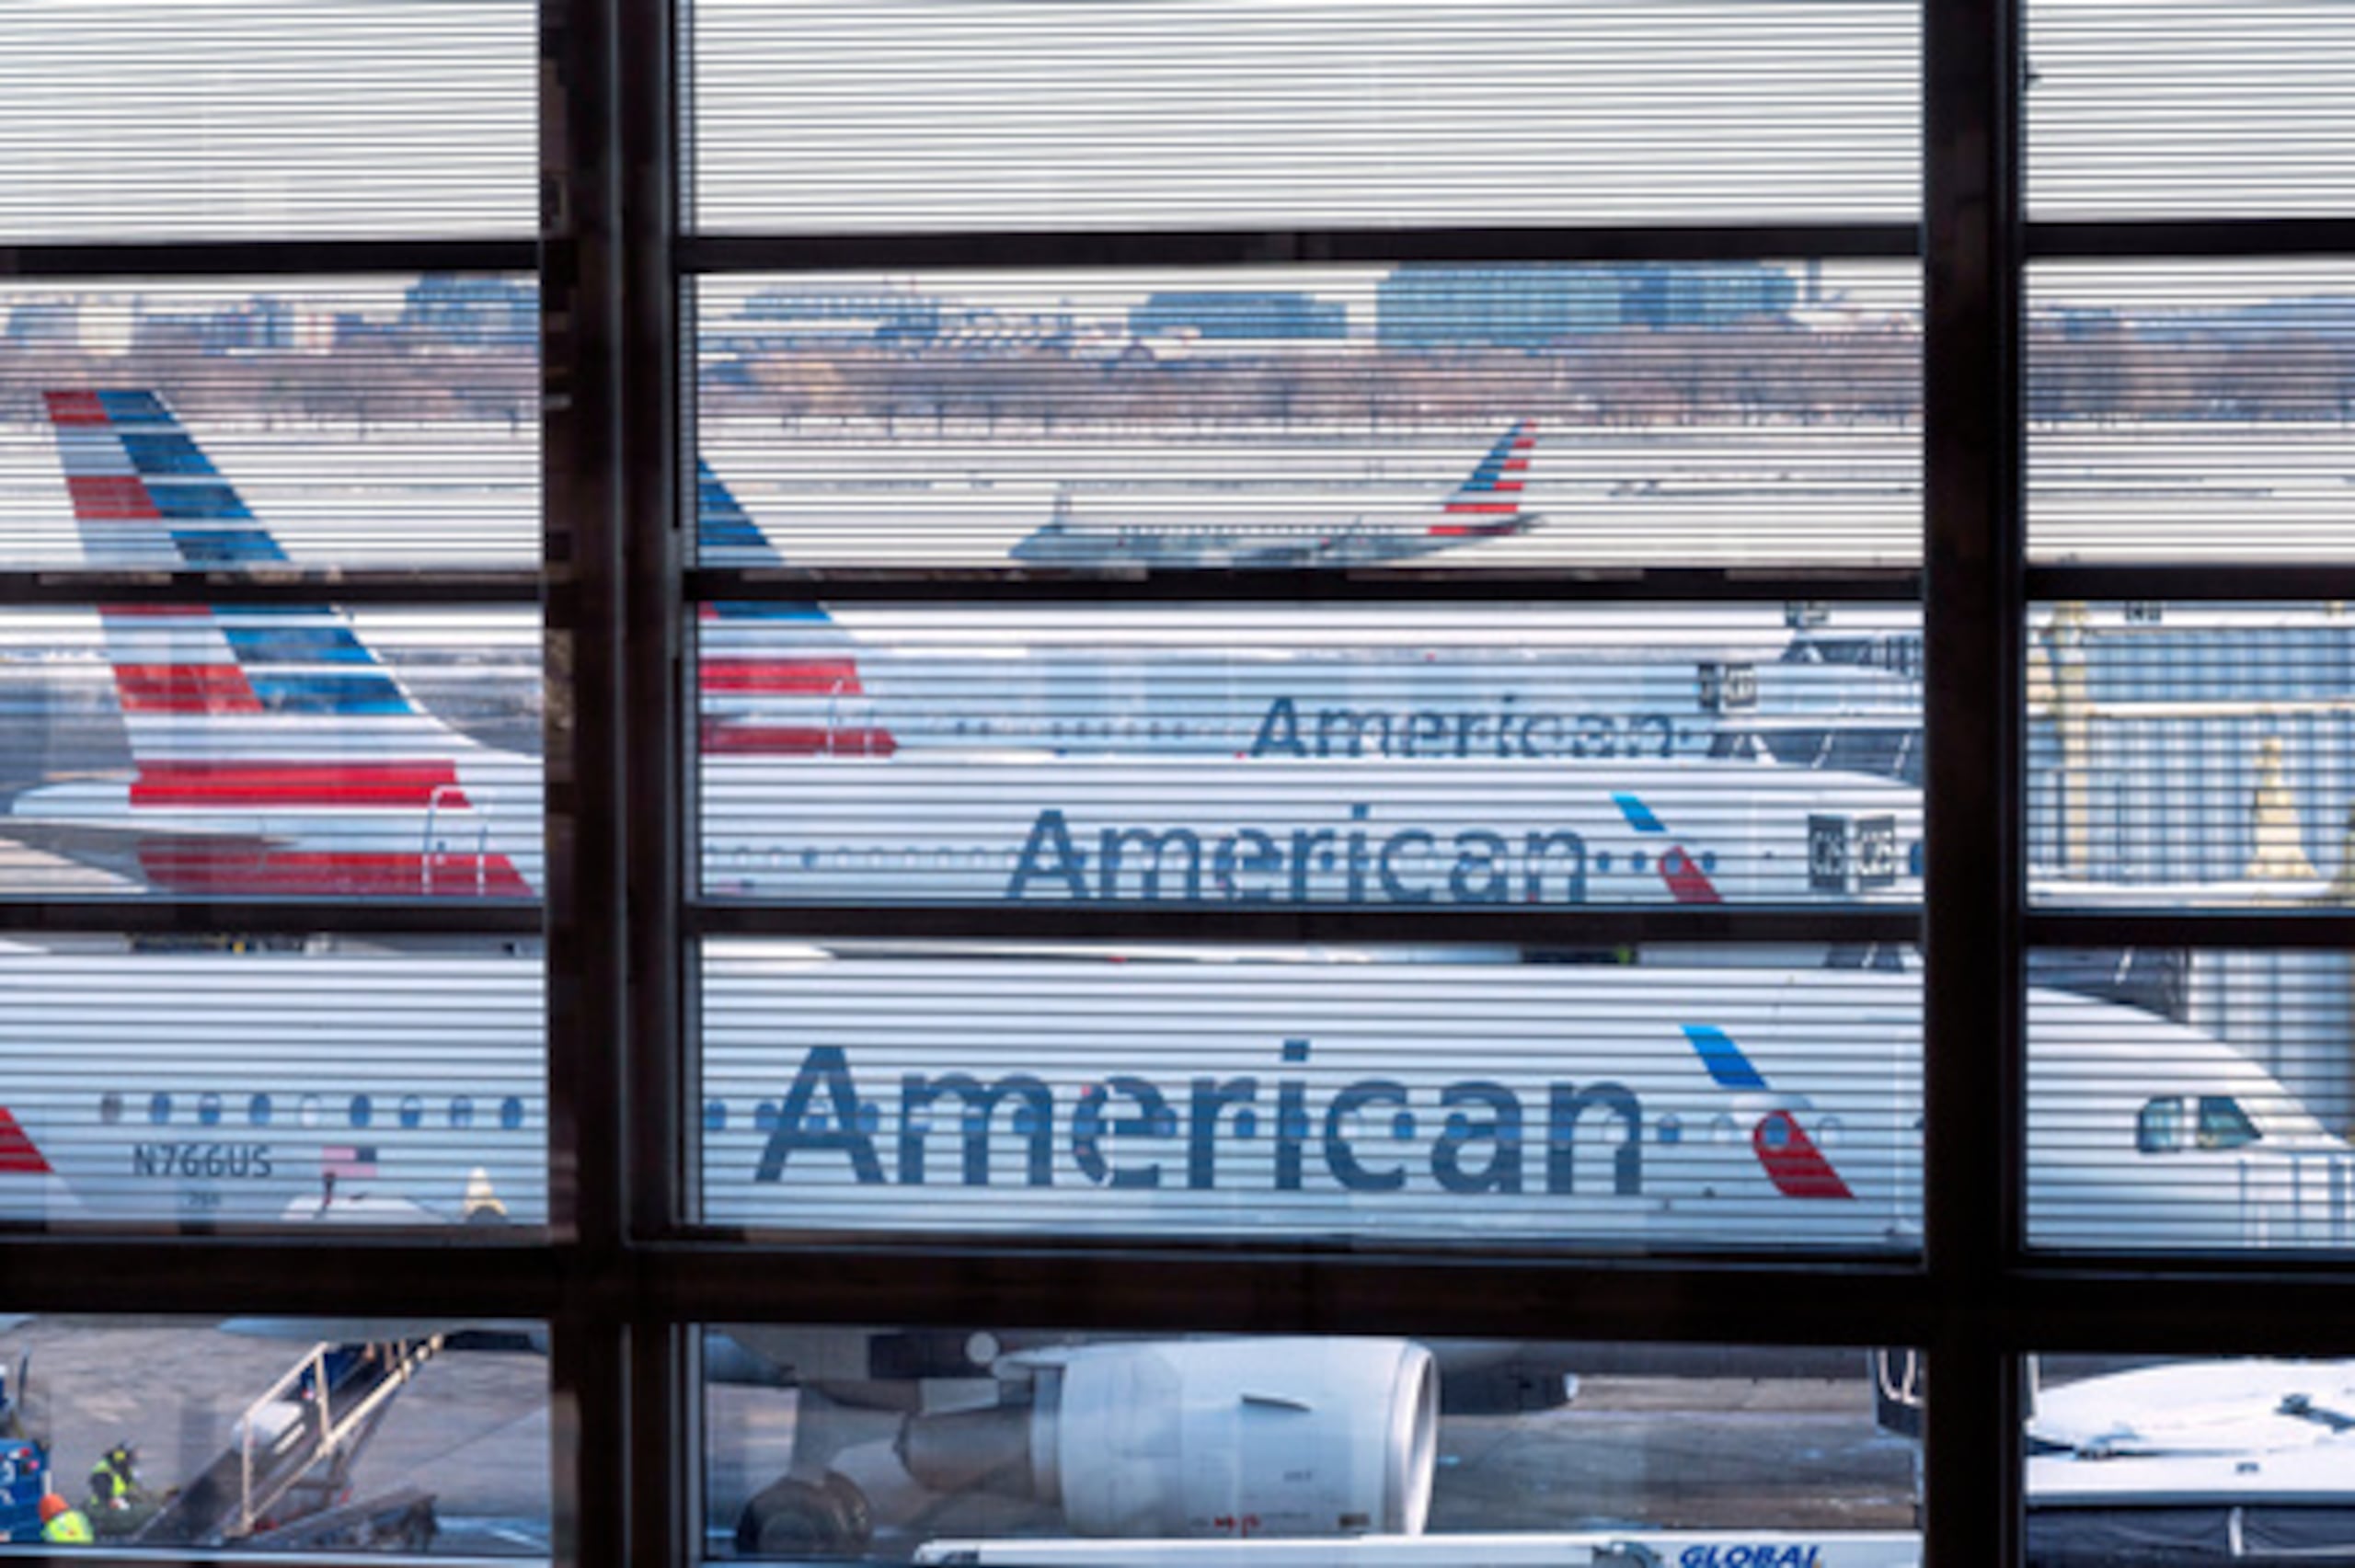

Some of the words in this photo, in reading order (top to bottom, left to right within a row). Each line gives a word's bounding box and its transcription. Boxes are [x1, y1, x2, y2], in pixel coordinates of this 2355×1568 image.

[1250, 693, 1672, 758] American
[1007, 803, 1587, 902] American
[753, 1039, 1643, 1195] American
[133, 1143, 272, 1178] N766US
